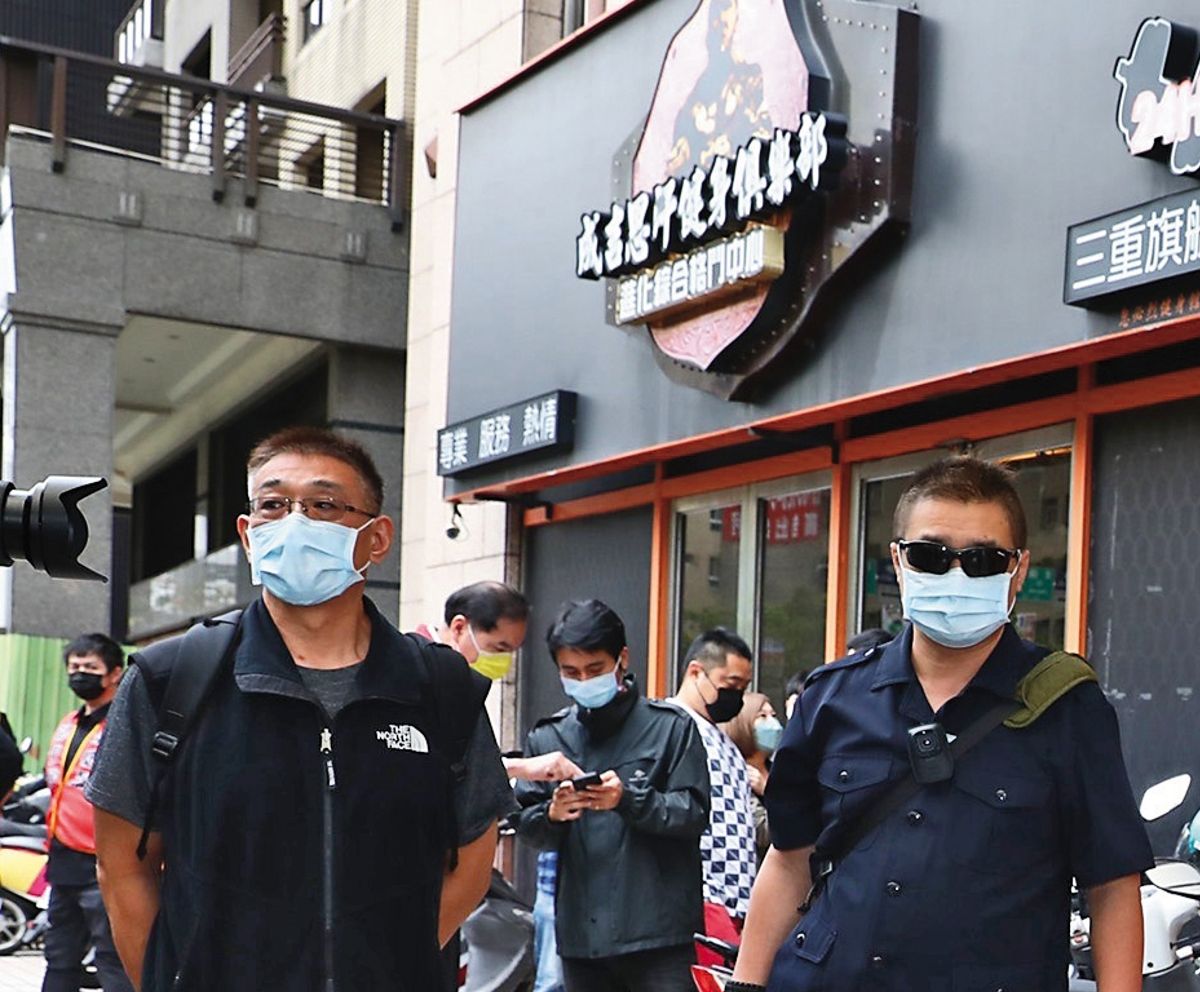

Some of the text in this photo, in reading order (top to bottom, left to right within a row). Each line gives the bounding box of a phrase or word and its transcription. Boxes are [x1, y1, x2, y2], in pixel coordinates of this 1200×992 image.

[577, 112, 828, 277] 成吉思汗健身俱樂部
[440, 398, 557, 469] 專業 服務 熱情
